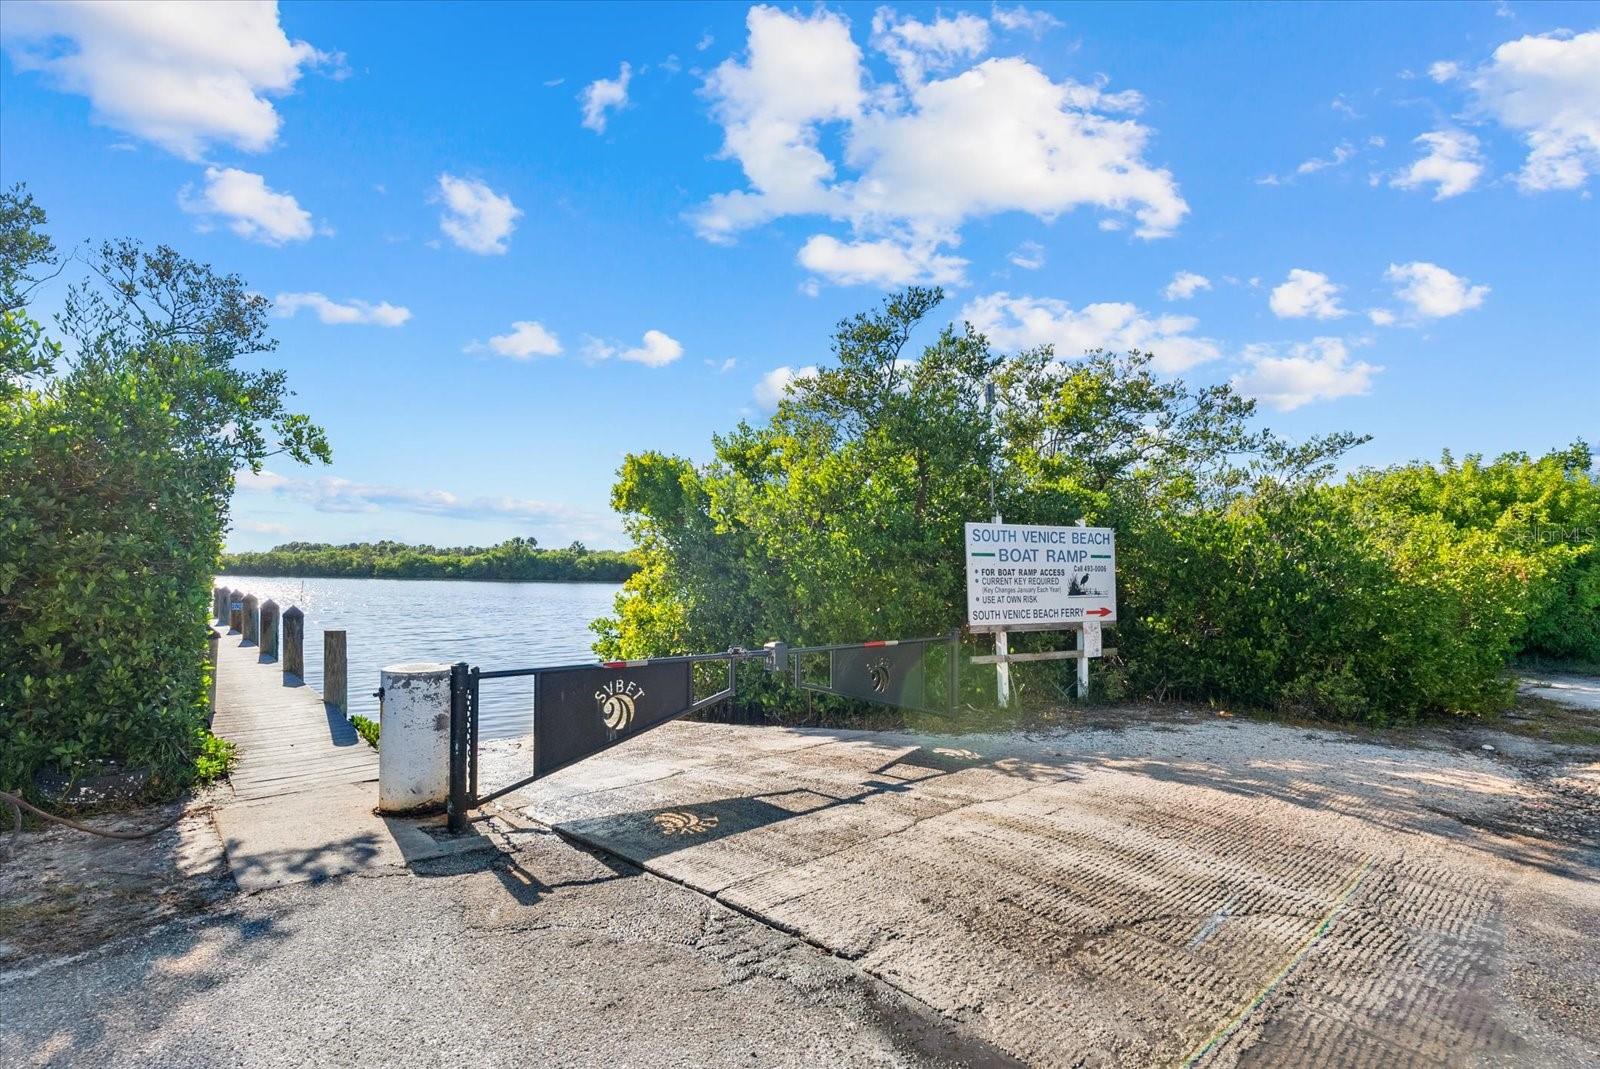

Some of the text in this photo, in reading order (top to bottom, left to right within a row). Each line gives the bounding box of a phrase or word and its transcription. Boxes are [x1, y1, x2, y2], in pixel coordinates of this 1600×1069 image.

[972, 528, 1111, 545] SOUTH VENICE BEACH
[998, 548, 1088, 563] BOAT RAMP
[981, 568, 1065, 577] FOR BOAT RAMP ACCESS
[981, 577, 1060, 586] CURRENT KEY REQUIRED
[994, 586, 1016, 595] Changes
[1017, 586, 1036, 595] January
[1036, 586, 1049, 594] Each
[982, 595, 1038, 605] USE AT OWN RISK
[972, 607, 1085, 621] SOUTH VENICE BEACH FERRY
[594, 679, 646, 703] SVBET
